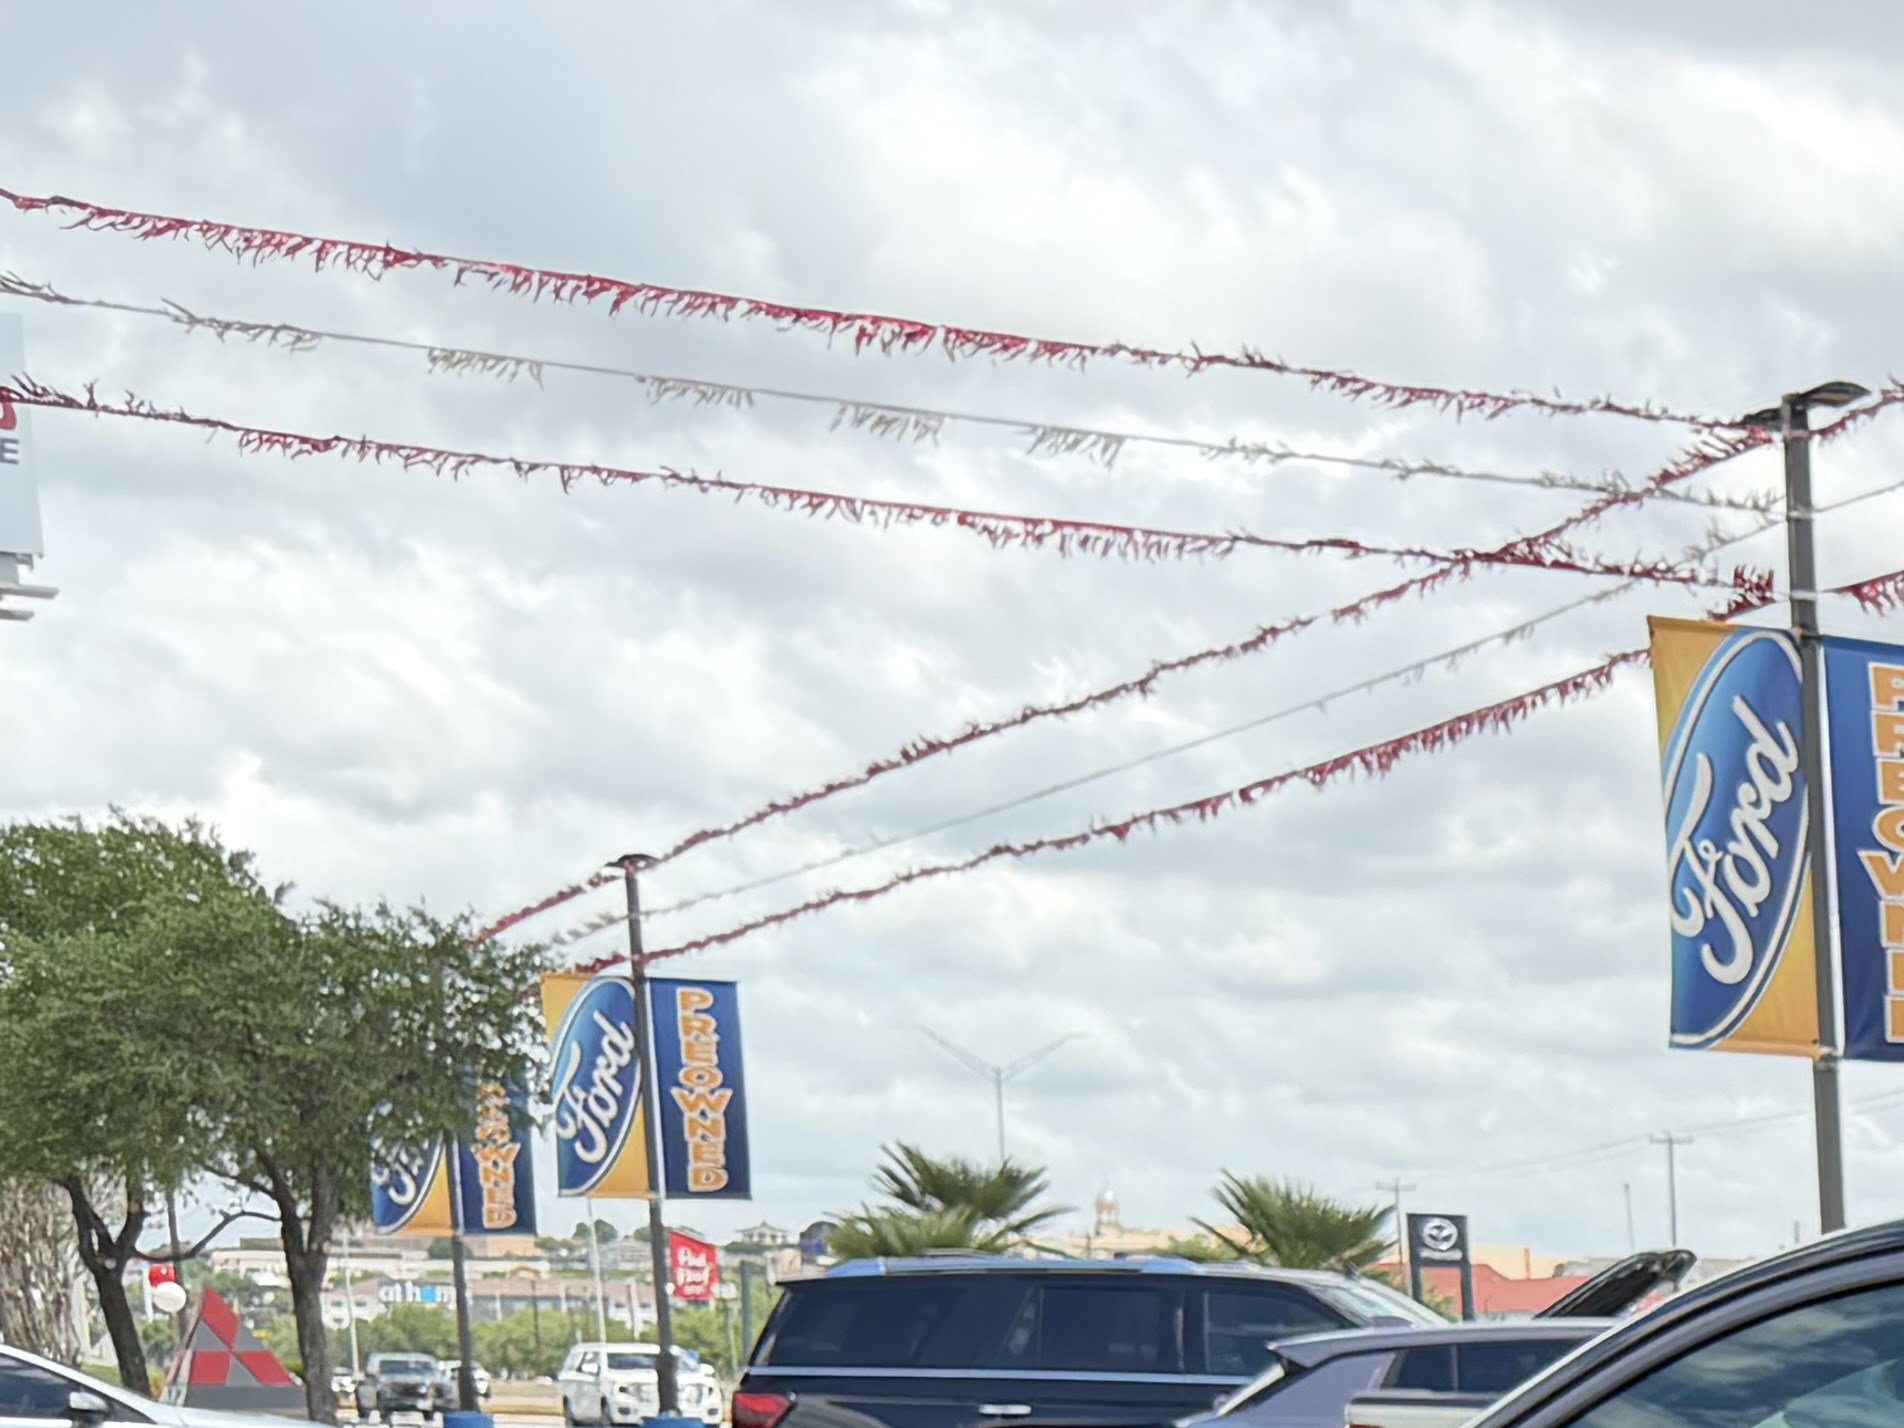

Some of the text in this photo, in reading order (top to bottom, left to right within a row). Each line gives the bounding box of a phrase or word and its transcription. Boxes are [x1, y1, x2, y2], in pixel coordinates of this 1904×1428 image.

[1669, 695, 1801, 986] Ford
[554, 1008, 635, 1164] Ford
[670, 986, 734, 1193] PREOWNED
